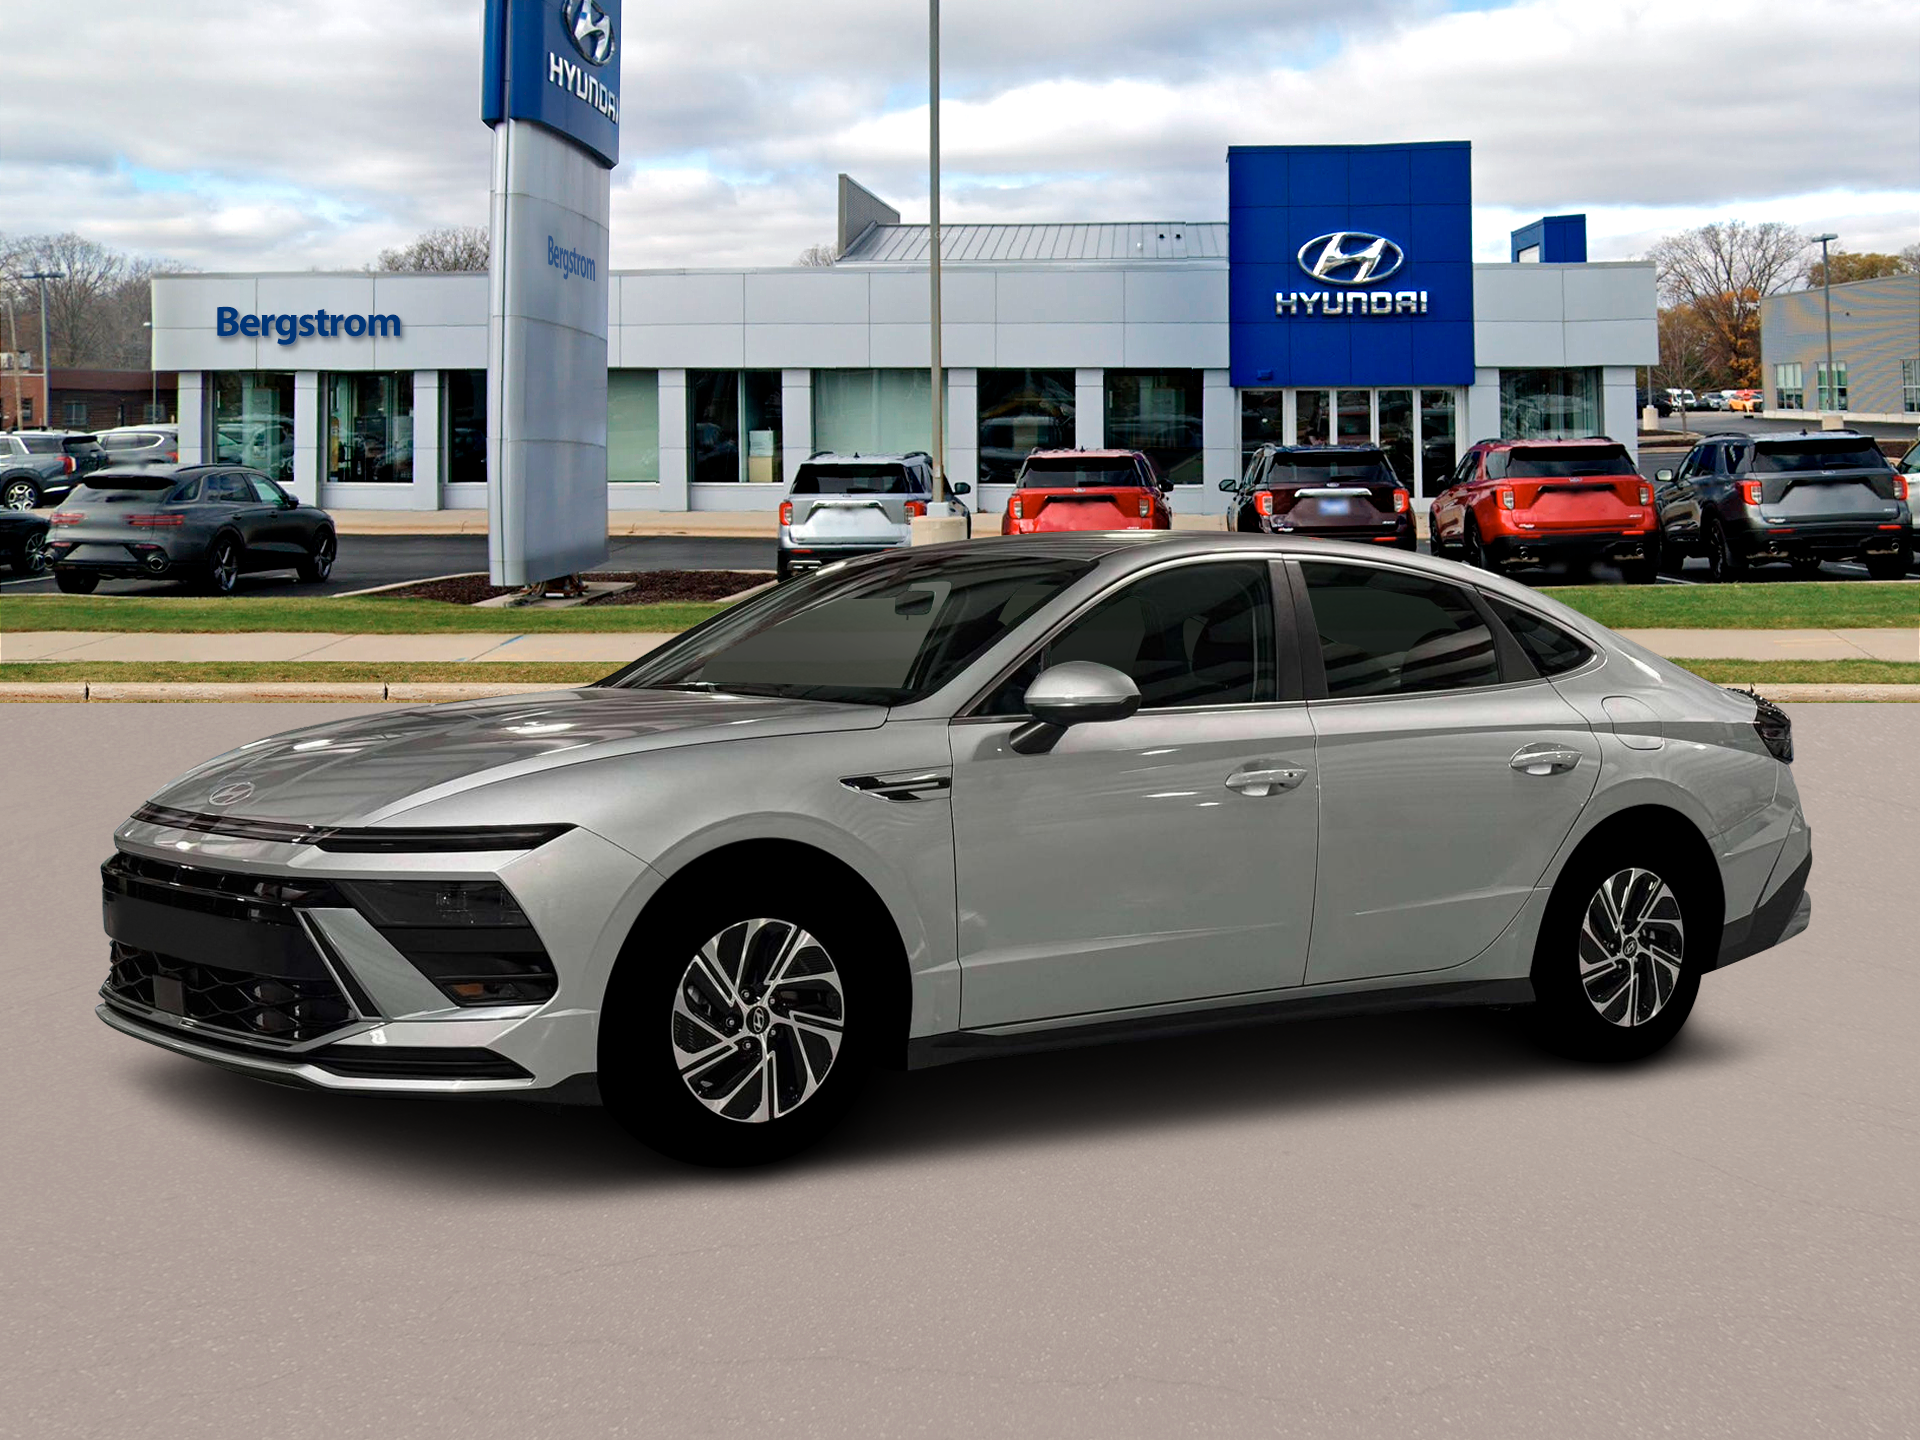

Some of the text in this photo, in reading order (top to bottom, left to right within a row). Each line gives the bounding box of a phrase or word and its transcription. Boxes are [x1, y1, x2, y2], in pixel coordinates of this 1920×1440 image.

[548, 52, 619, 124] HYUNDAI
[547, 235, 596, 282] Bergstrom
[1275, 291, 1428, 315] HYUNDAI
[216, 306, 401, 346] Bergstrom
